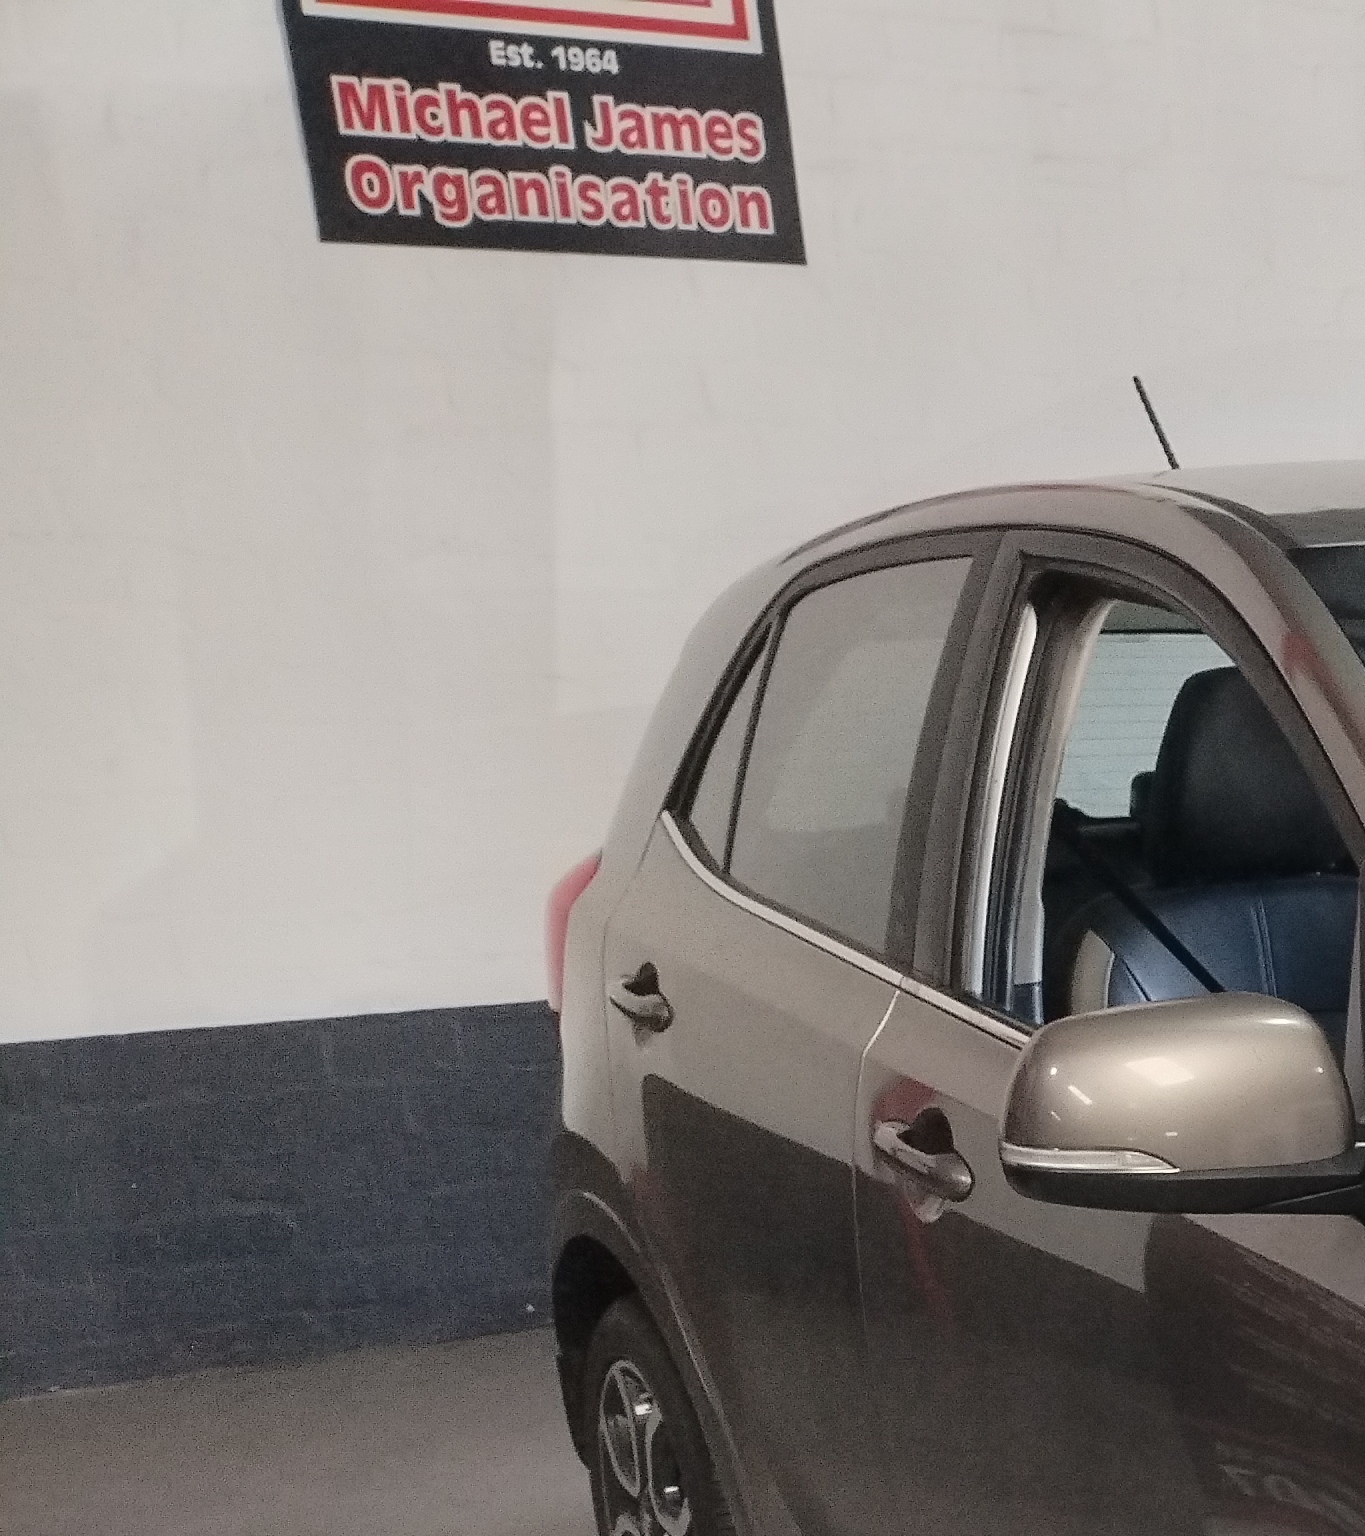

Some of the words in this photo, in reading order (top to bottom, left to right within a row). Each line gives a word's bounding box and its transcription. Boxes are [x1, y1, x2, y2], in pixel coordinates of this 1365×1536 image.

[489, 39, 542, 69] Est.
[551, 44, 620, 75] 1964
[331, 75, 573, 149] Michael
[585, 96, 765, 162] James
[346, 155, 774, 234] Organisation
